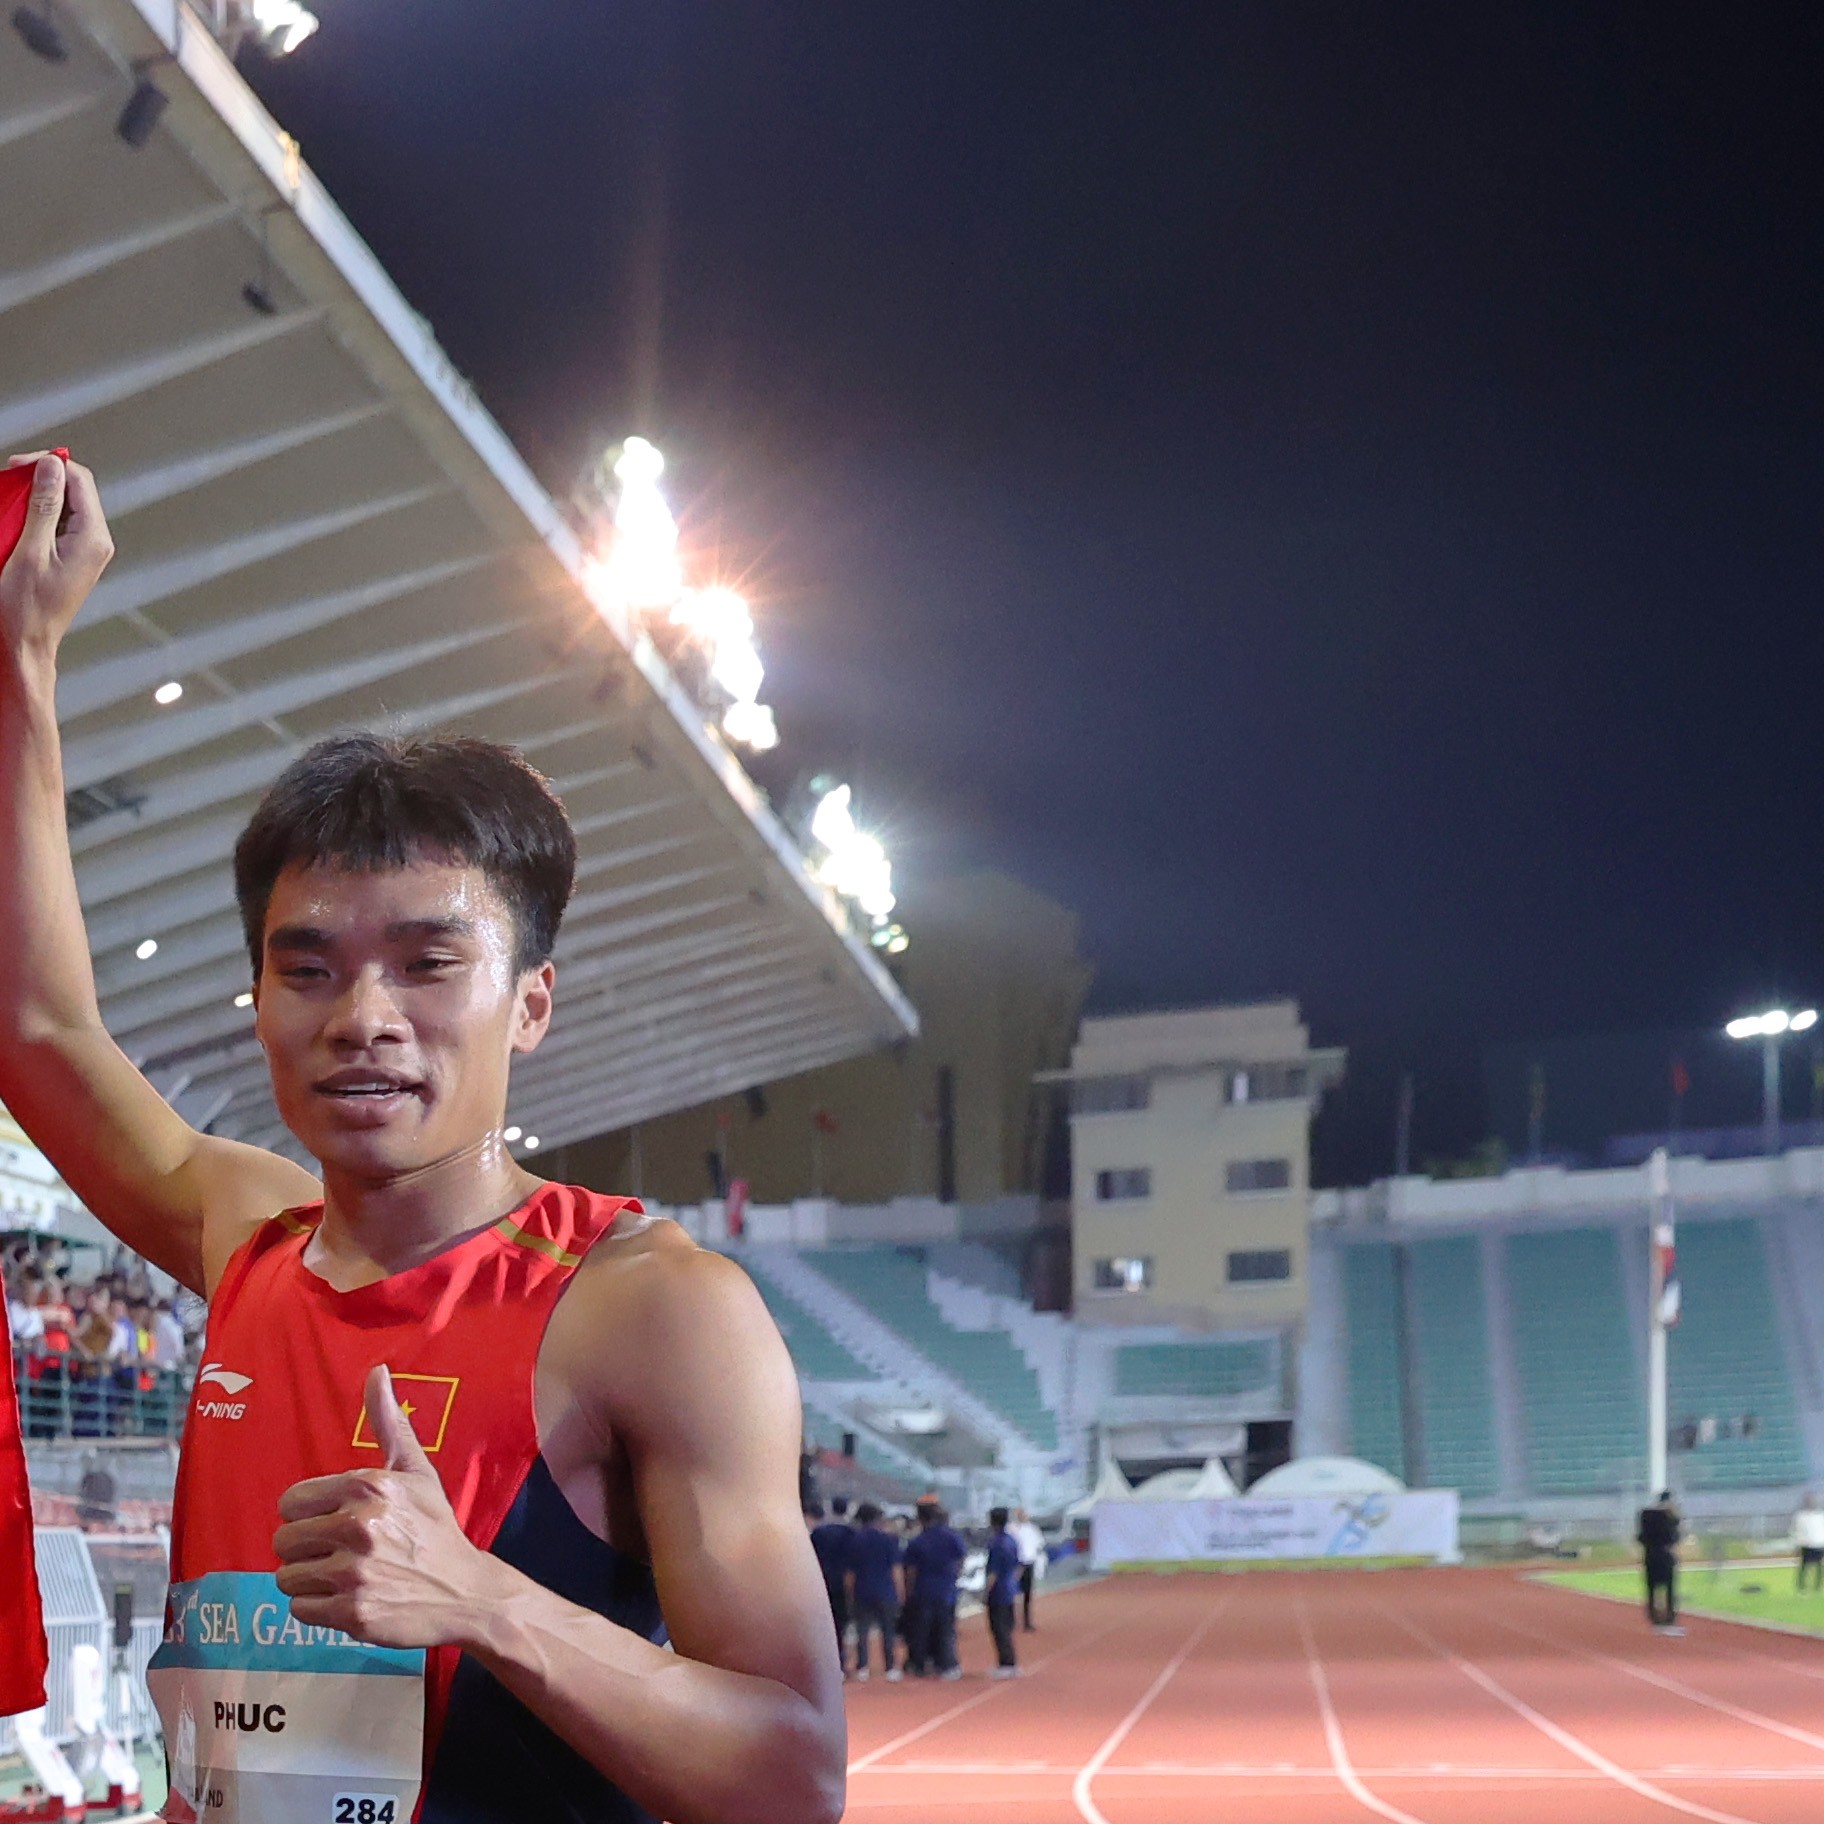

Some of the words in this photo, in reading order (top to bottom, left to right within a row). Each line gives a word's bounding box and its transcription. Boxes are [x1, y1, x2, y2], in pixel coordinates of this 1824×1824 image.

[195, 1400, 247, 1420] I-NING
[199, 1602, 240, 1644] SEA
[214, 1701, 286, 1733] PHUC
